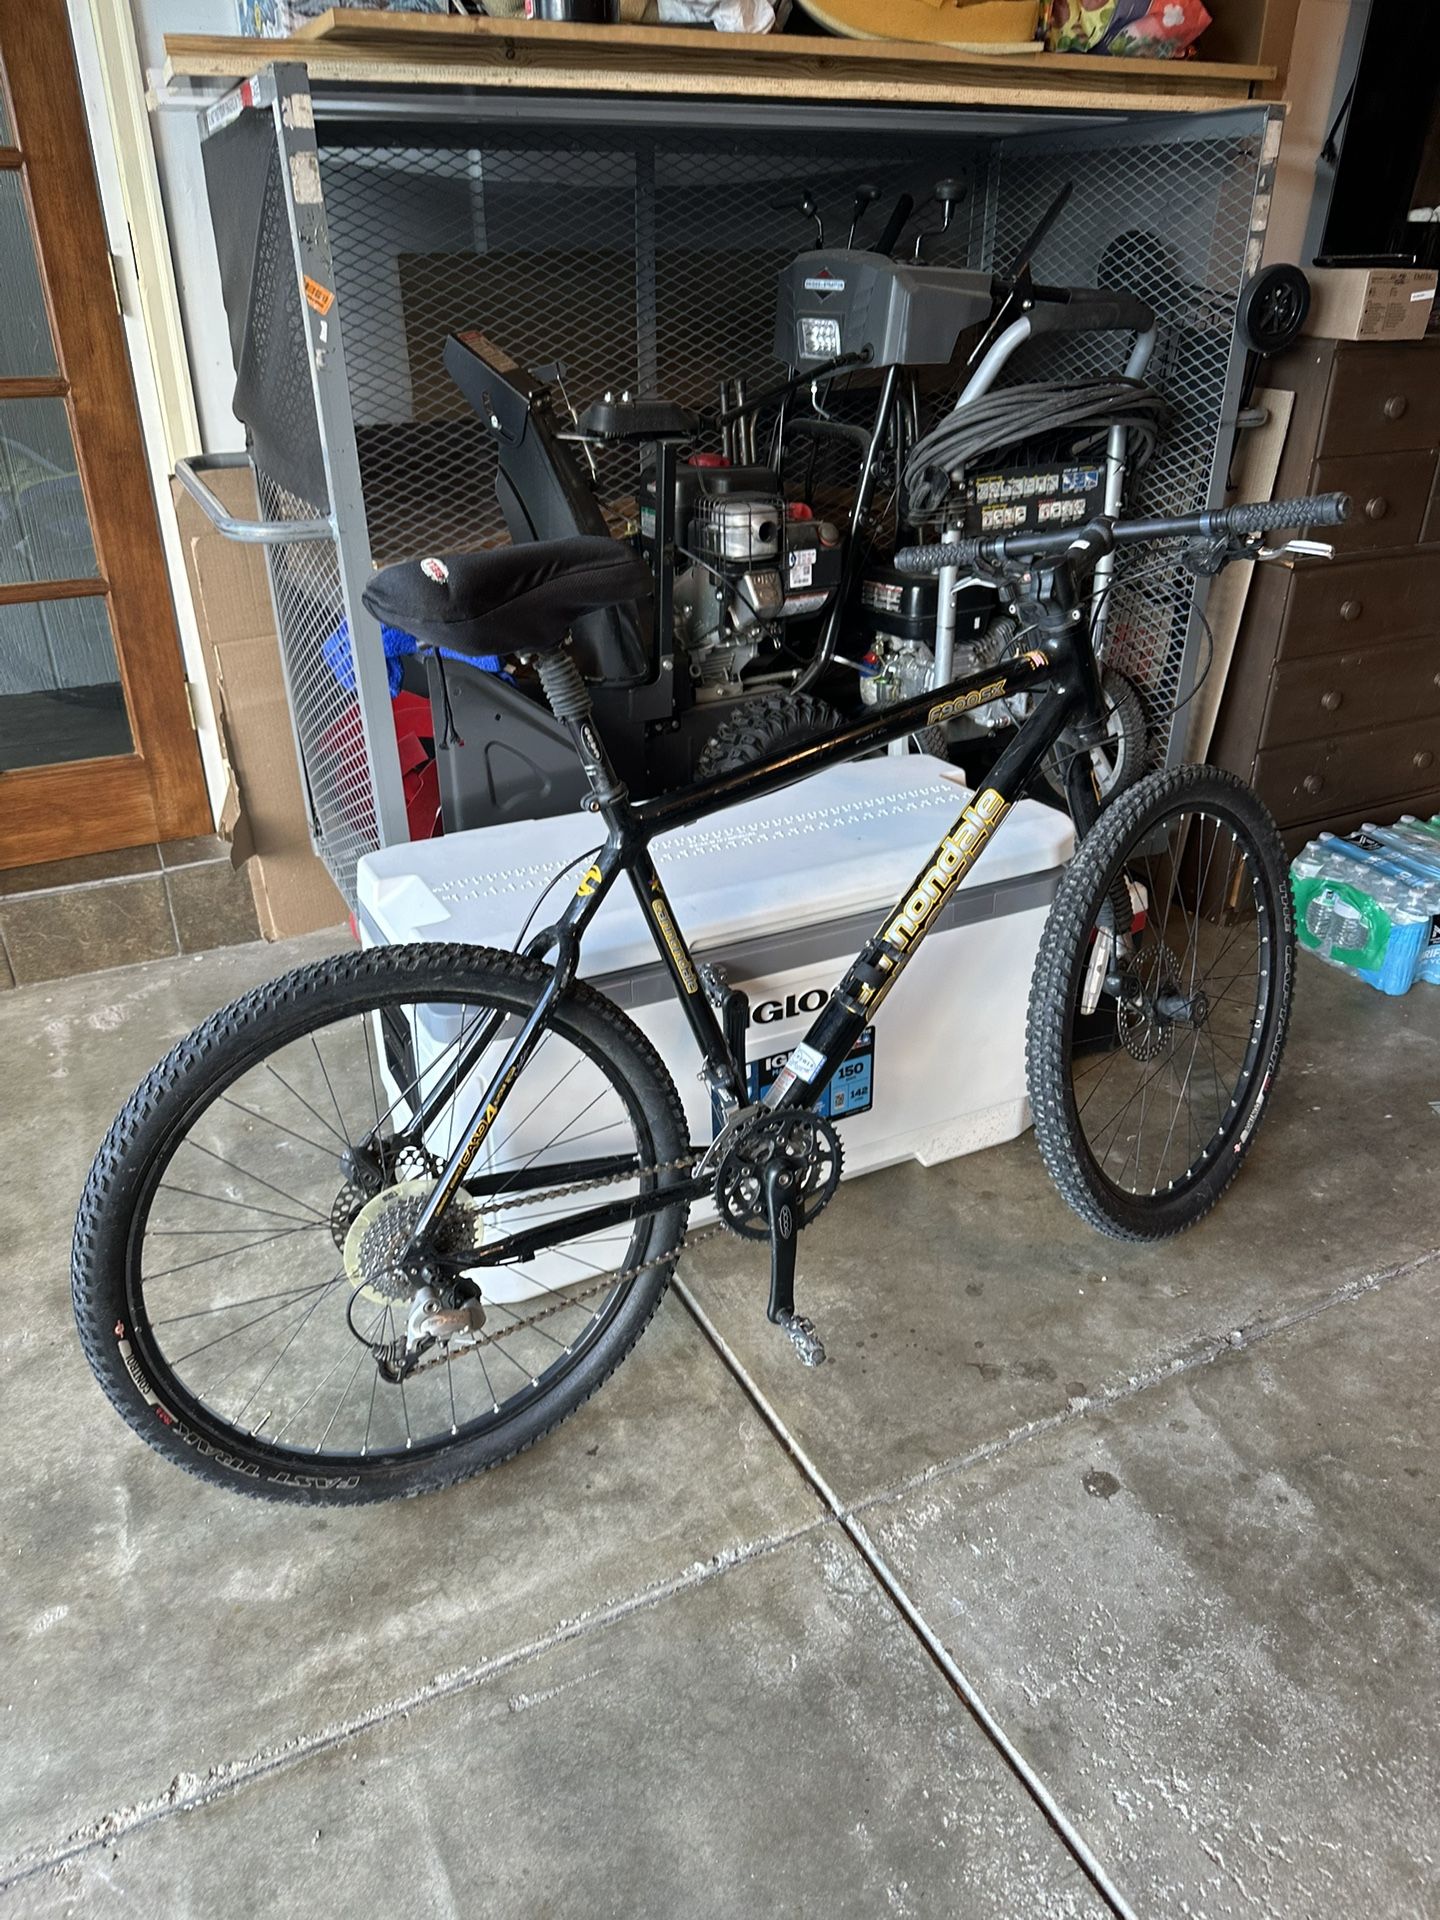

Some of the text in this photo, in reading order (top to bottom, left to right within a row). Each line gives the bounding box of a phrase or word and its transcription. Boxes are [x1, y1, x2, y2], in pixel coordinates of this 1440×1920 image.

[858, 788, 1005, 1006] nondale
[838, 1062, 864, 1080] 150
[850, 1086, 868, 1099] 142
[125, 1352, 152, 1395] CONTROL
[172, 1422, 361, 1490] FAST TRAK
